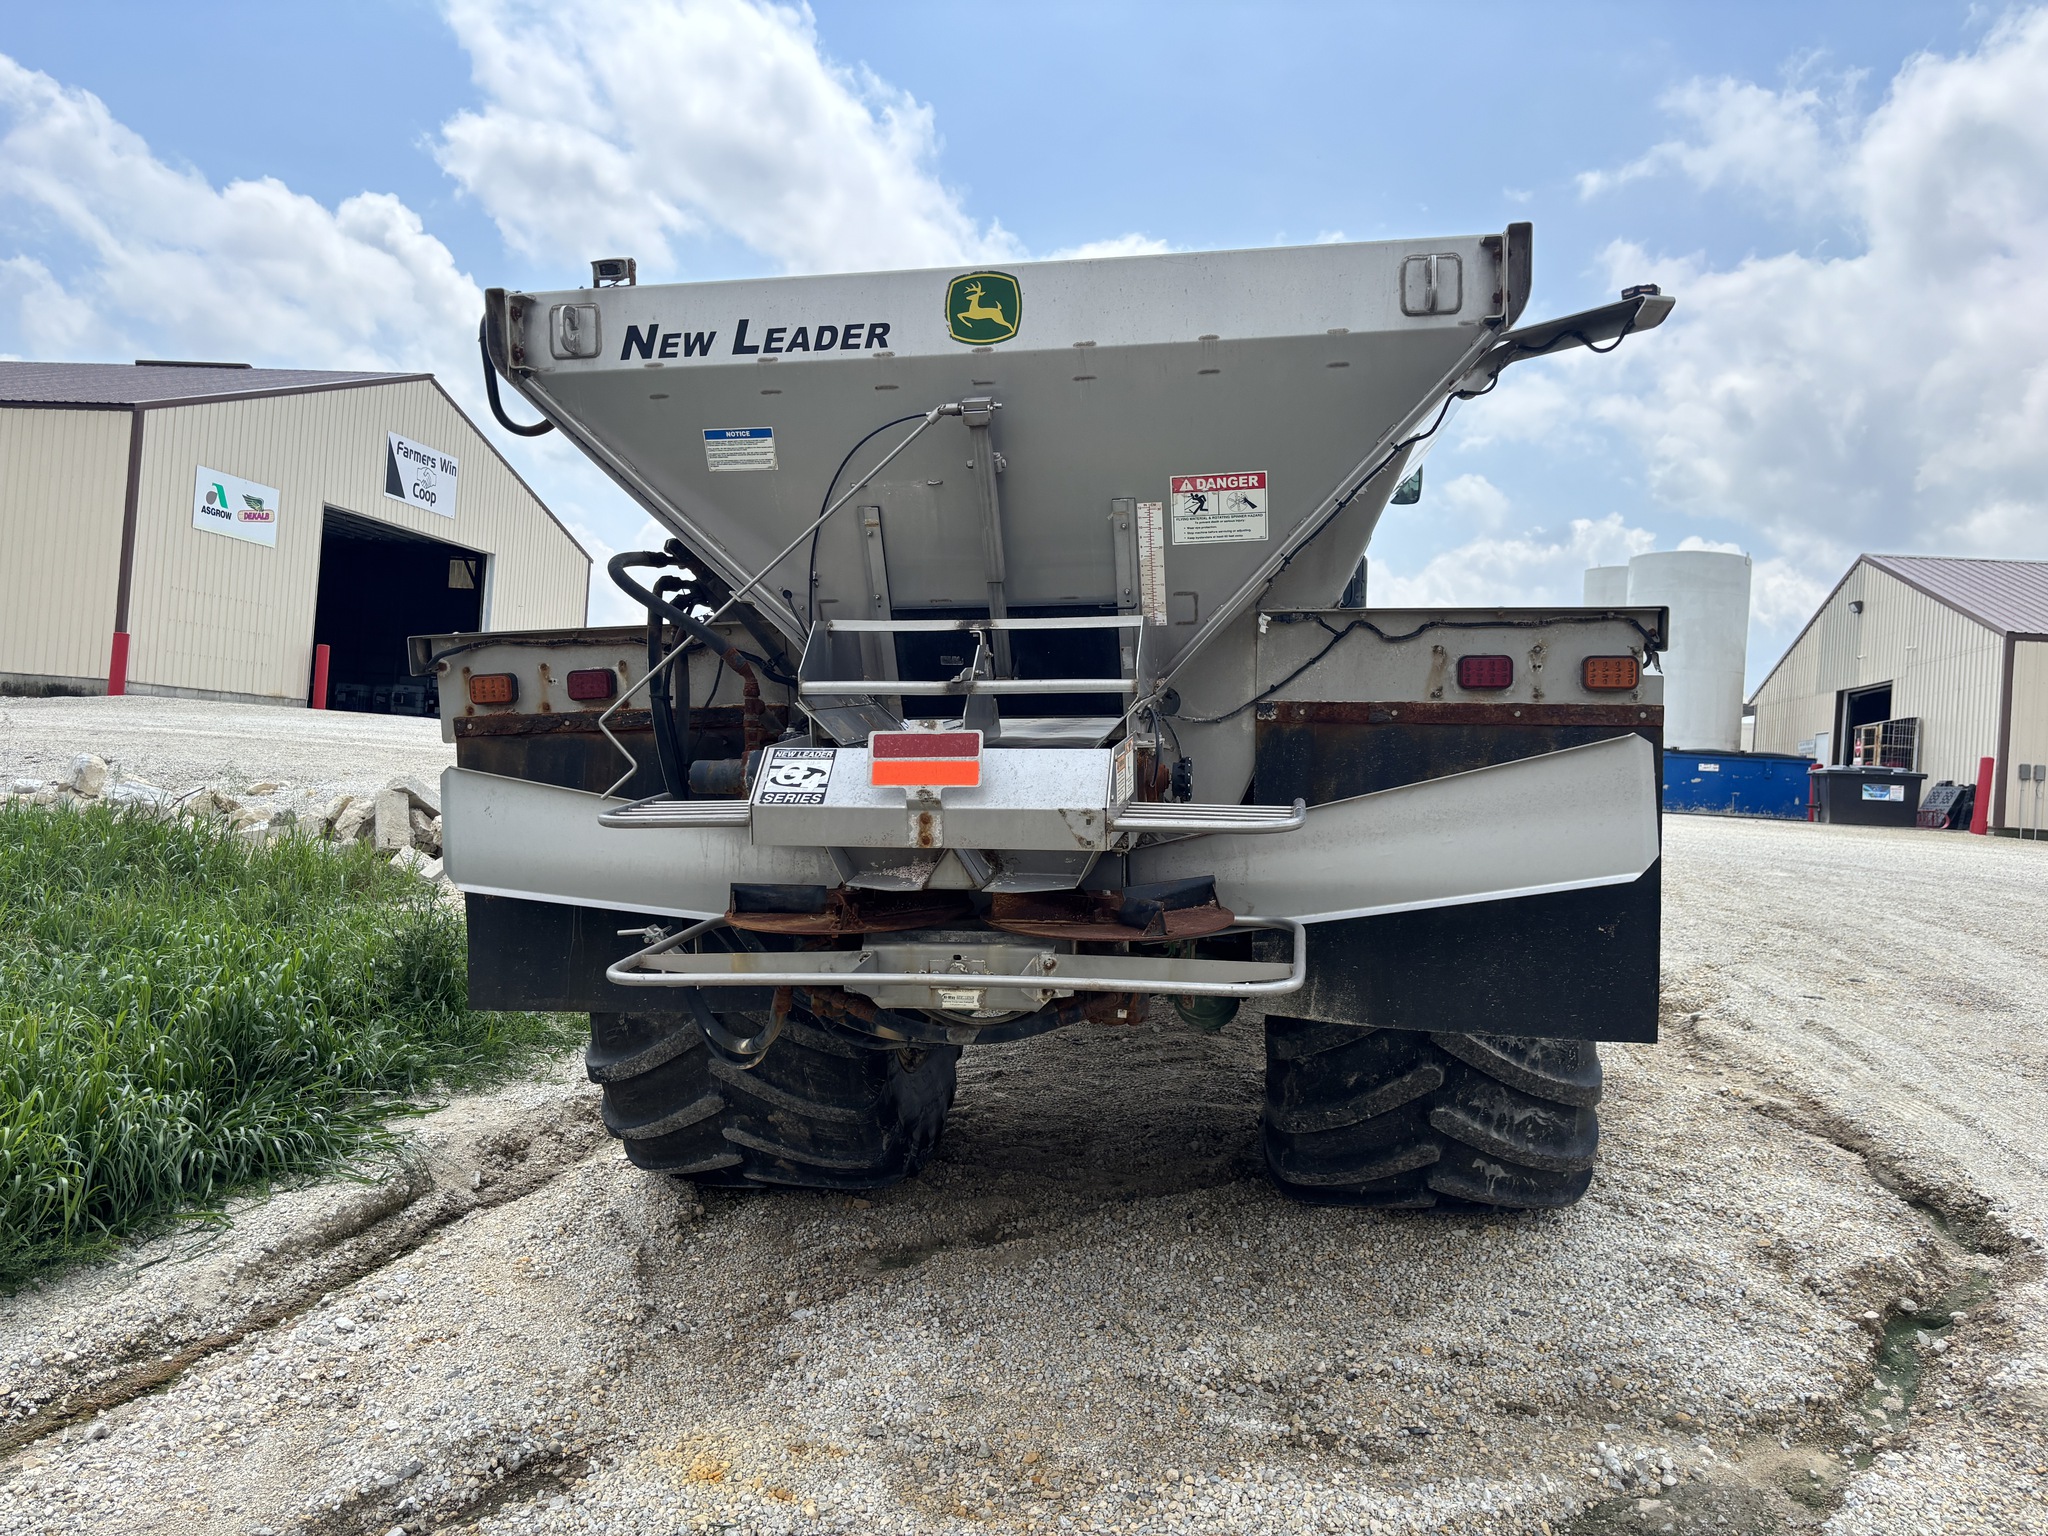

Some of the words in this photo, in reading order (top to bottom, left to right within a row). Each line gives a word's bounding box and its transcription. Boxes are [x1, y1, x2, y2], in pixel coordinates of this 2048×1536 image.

[620, 324, 717, 360] NEW
[732, 318, 891, 355] LEADER
[725, 430, 751, 438] NOTICE
[396, 440, 437, 469] Farmers
[440, 457, 457, 477] Win
[1196, 475, 1259, 490] DANGER
[412, 482, 437, 507] Coop
[201, 505, 232, 520] ASGROW
[243, 512, 270, 520] DEKALB
[775, 750, 797, 758] NEW
[798, 750, 834, 758] LEADER
[775, 762, 822, 791] G4
[762, 793, 823, 803] SERIES
